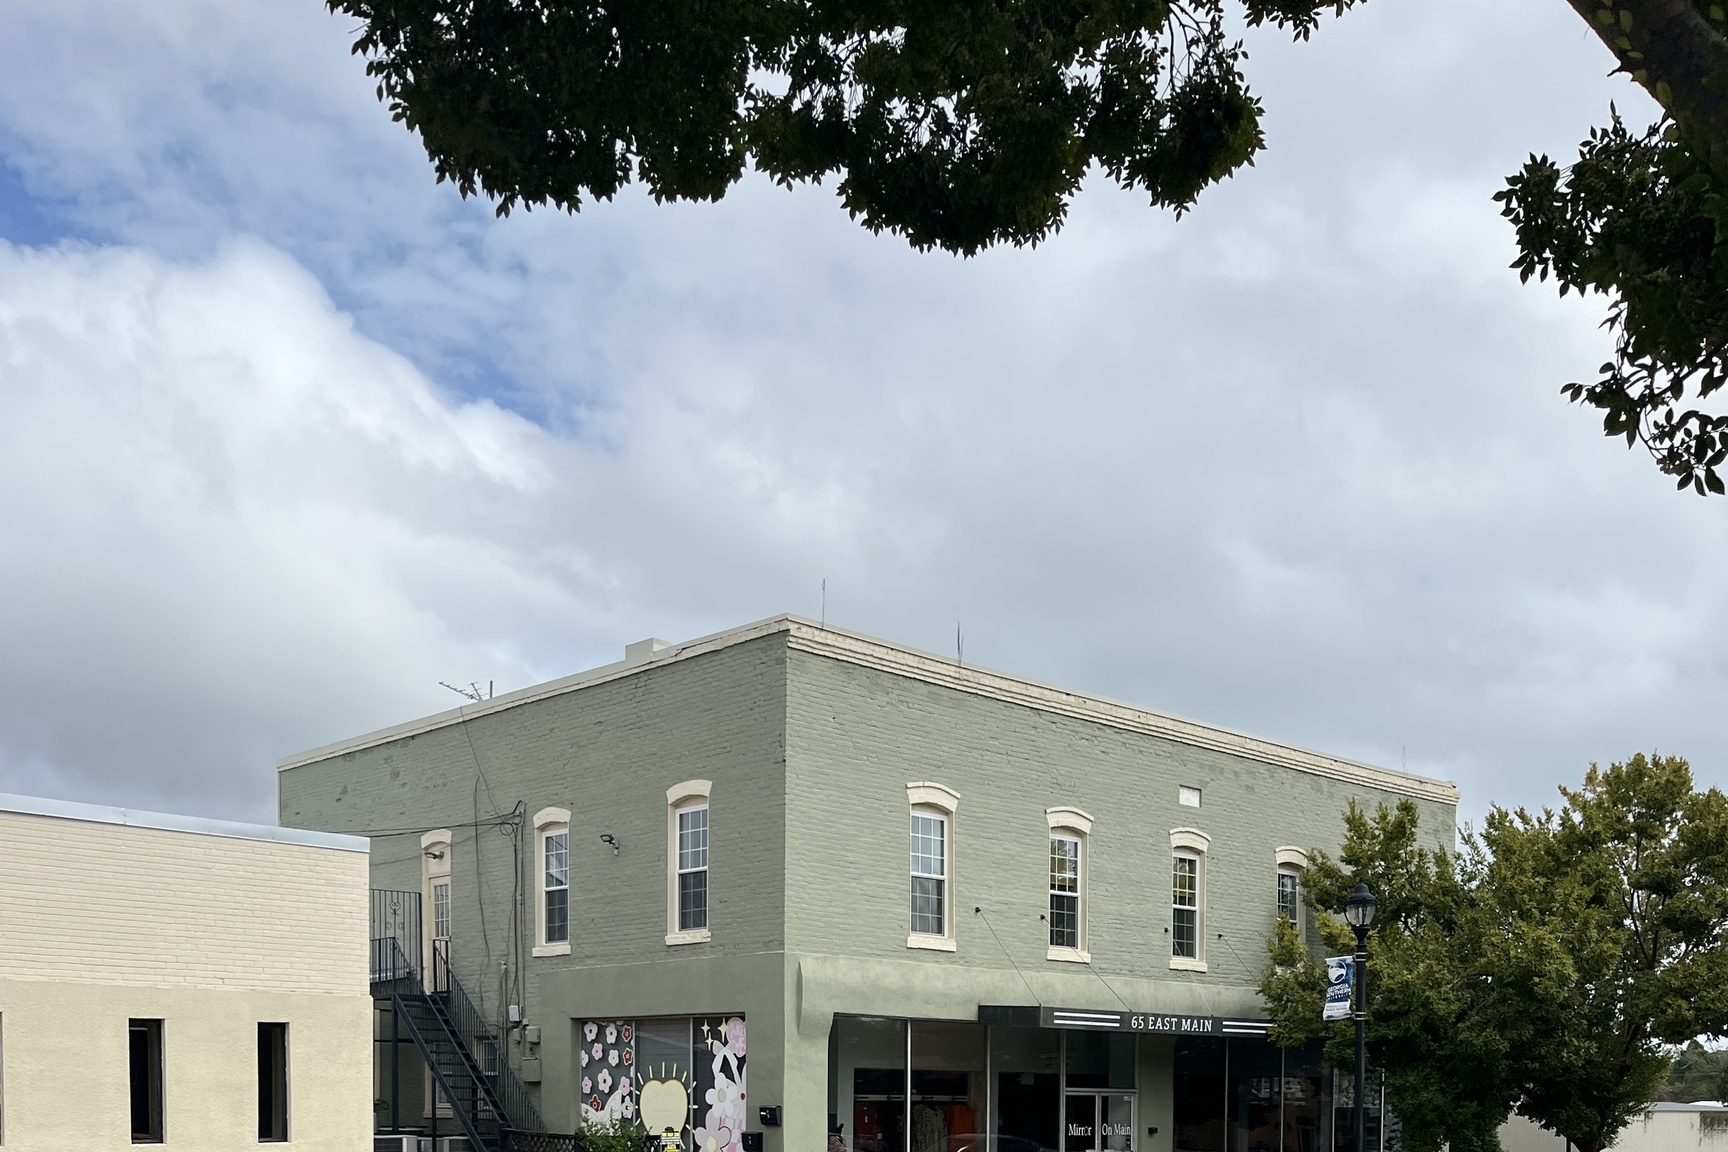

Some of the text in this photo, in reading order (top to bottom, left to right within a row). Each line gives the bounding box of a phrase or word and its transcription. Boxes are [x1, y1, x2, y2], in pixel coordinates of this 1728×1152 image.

[1131, 1016, 1213, 1032] 65 EAST MAIN
[1068, 1123, 1131, 1136] Mirror On Main
